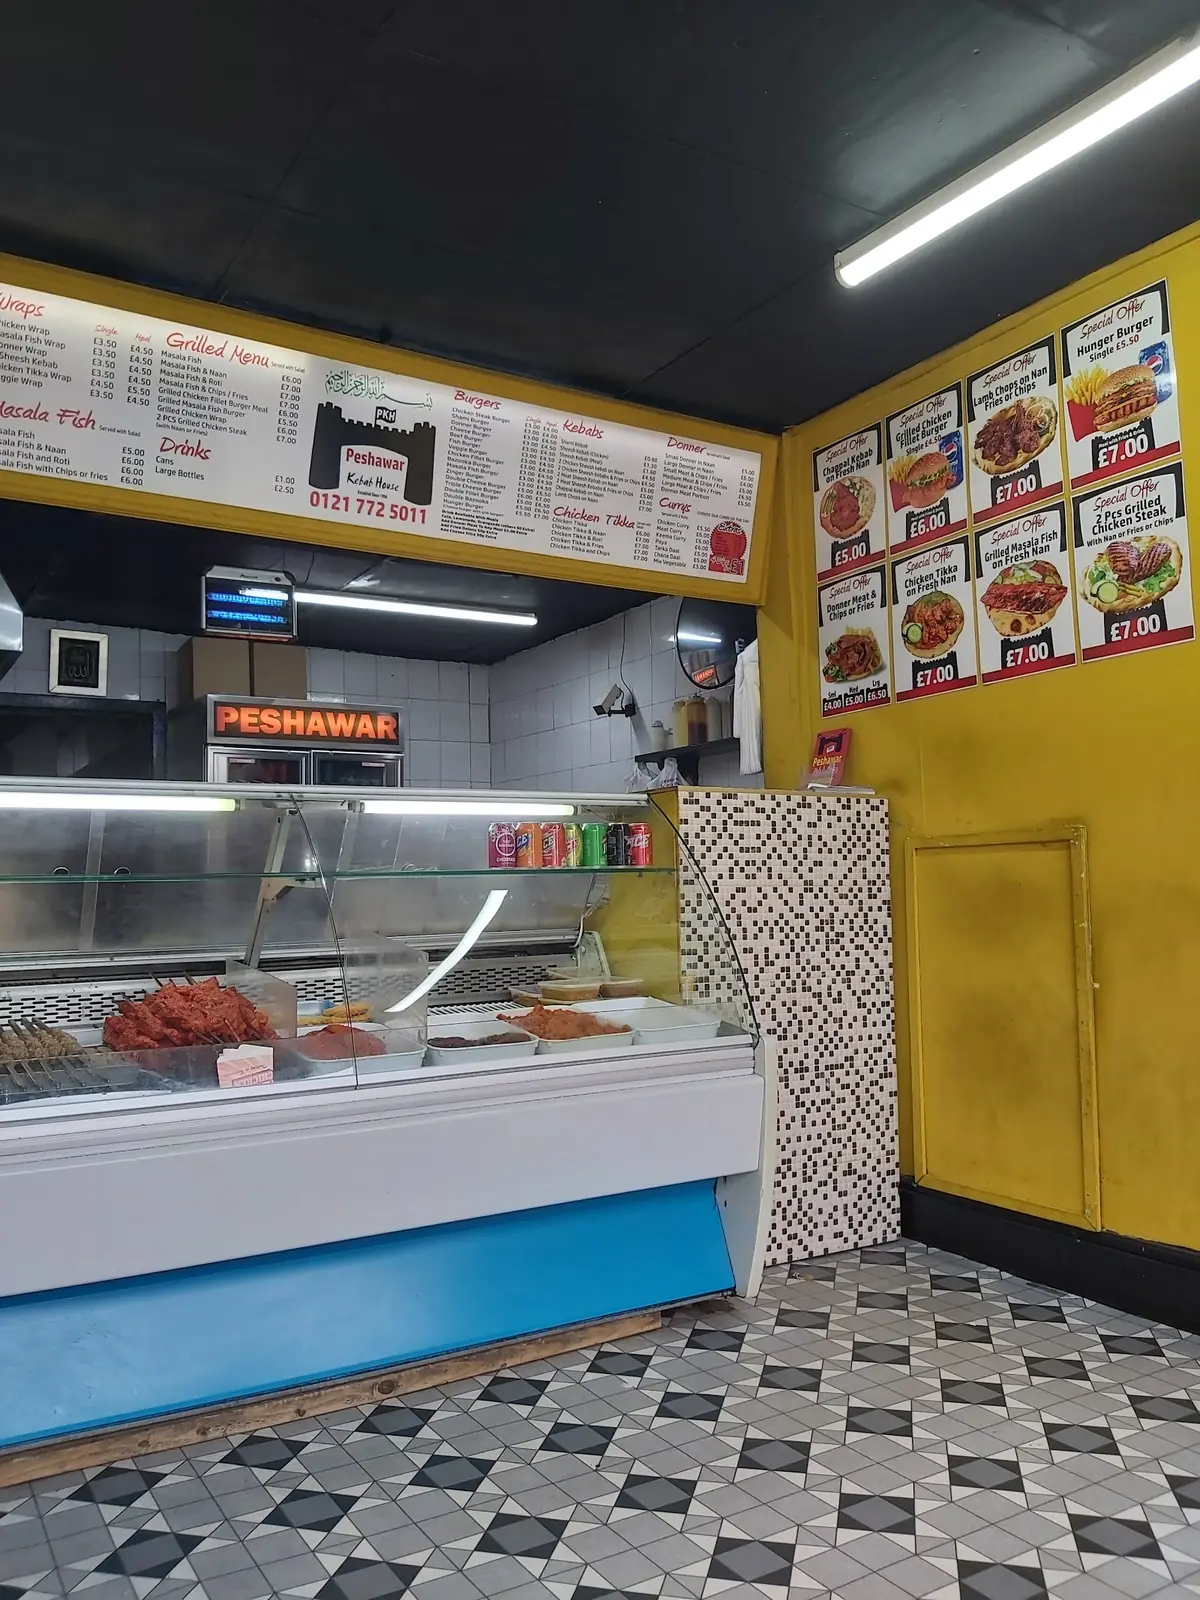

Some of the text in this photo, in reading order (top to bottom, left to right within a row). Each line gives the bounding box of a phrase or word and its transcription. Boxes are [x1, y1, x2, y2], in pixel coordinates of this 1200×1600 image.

[1080, 299, 1145, 340] Special Offer
[1077, 316, 1154, 357] Hunger Burger
[1090, 334, 1139, 362] Single £5.50
[161, 350, 202, 364] Masala Fish
[167, 333, 269, 367] Grilled Menu
[160, 360, 185, 369] Masala
[187, 365, 201, 373] Fish
[210, 370, 227, 378] Naan
[983, 353, 1036, 388] Special Offer
[159, 378, 183, 388] Masala
[186, 383, 199, 391] Fish
[208, 387, 226, 397] Chips
[232, 392, 248, 400] Fries
[974, 367, 1047, 406] Lamb Chops on Nan
[984, 382, 1036, 411] Fries or Chips
[158, 396, 245, 418] Grilled Masala Fish Burger
[159, 387, 268, 413] Grilled Chicken Fillet Burger Meal
[454, 390, 501, 410] Burgers
[900, 396, 947, 428] Special Offer
[57, 409, 96, 429] Fish
[157, 405, 226, 423] Grilled Chicken Wrap
[163, 415, 176, 423] PCS
[178, 418, 200, 427] Grilled
[202, 423, 227, 432] Chicken
[229, 427, 247, 435] Steak
[376, 408, 396, 421] PKH
[896, 410, 952, 442] Grilled Chicken
[563, 419, 604, 439] Kebabs
[900, 421, 947, 449] Fillet Burger
[160, 436, 211, 460] Drinks
[667, 437, 707, 454] Donner
[826, 434, 868, 462] Special Offer
[906, 435, 942, 456] Single £4.50
[1098, 434, 1148, 468] £7.00
[156, 456, 174, 465] Cans
[346, 448, 405, 471] Peshawar
[823, 448, 873, 477] Chappal Kebab
[826, 459, 870, 483] on Fresh Nan
[155, 466, 204, 480] Large Bottles
[276, 475, 295, 484] £1.00
[347, 472, 399, 491] Kebab House
[275, 485, 294, 494] £2.50
[996, 474, 1036, 505] £7.00
[1093, 479, 1160, 512] Special Offer
[310, 491, 349, 512] 0121
[356, 498, 384, 517] 772
[389, 504, 427, 524] 5011
[554, 506, 600, 522] Chicken
[605, 514, 635, 529] Tikka
[660, 498, 691, 514] Currys
[1096, 495, 1160, 524] 2 Pcs Grilled
[910, 511, 945, 538] £6.00
[991, 514, 1047, 546] Special Offer
[1087, 536, 1102, 547] With
[1104, 533, 1117, 542] Nan
[1127, 525, 1143, 536] Fries
[1155, 516, 1173, 527] Chips
[1092, 504, 1166, 536] Chicken Steak
[835, 542, 866, 566] £5.00
[985, 530, 1057, 562] Grilled Masala Fish
[992, 544, 1050, 569] on Fresh Nan
[905, 547, 954, 575] Special Offer
[829, 575, 872, 600] Special Offer
[905, 565, 958, 588] Chicken Tikka
[907, 574, 956, 597] on Fresh Nan
[827, 590, 876, 612] Donner Meat &
[829, 601, 874, 621] Chips or Fries
[1110, 613, 1160, 641] £7.00
[1006, 642, 1049, 667] £7.00
[917, 664, 953, 687] £7.00
[824, 689, 886, 711] £4.00 £5.00 £6.50
[216, 706, 397, 740] PESHAWAR
